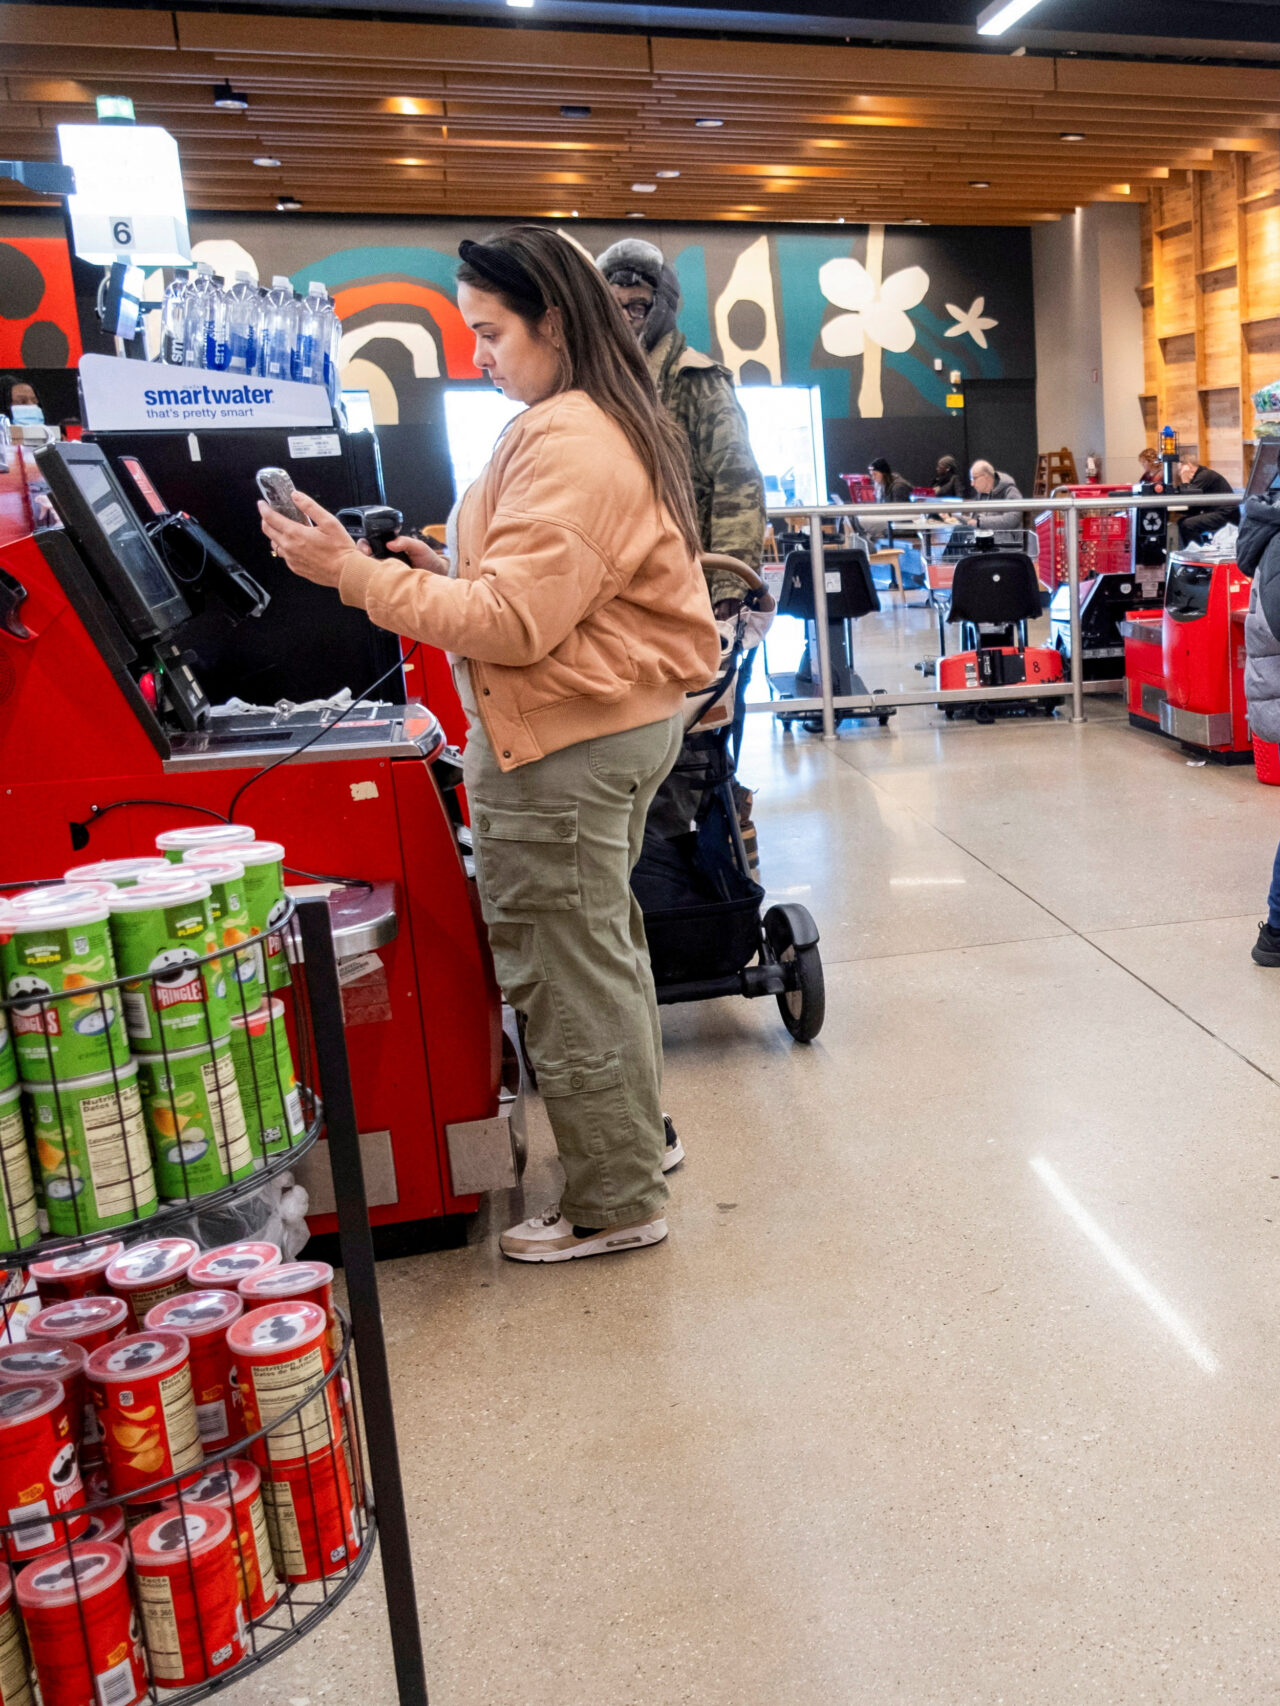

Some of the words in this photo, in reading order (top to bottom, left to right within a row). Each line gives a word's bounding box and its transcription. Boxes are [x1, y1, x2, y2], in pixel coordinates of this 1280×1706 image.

[113, 221, 132, 245] 6
[144, 384, 273, 406] smartwater
[146, 408, 179, 419] that's
[183, 408, 217, 421] pretty
[220, 407, 254, 418] smart
[1033, 661, 1041, 673] 8
[252, 1362, 296, 1372] Nutrition
